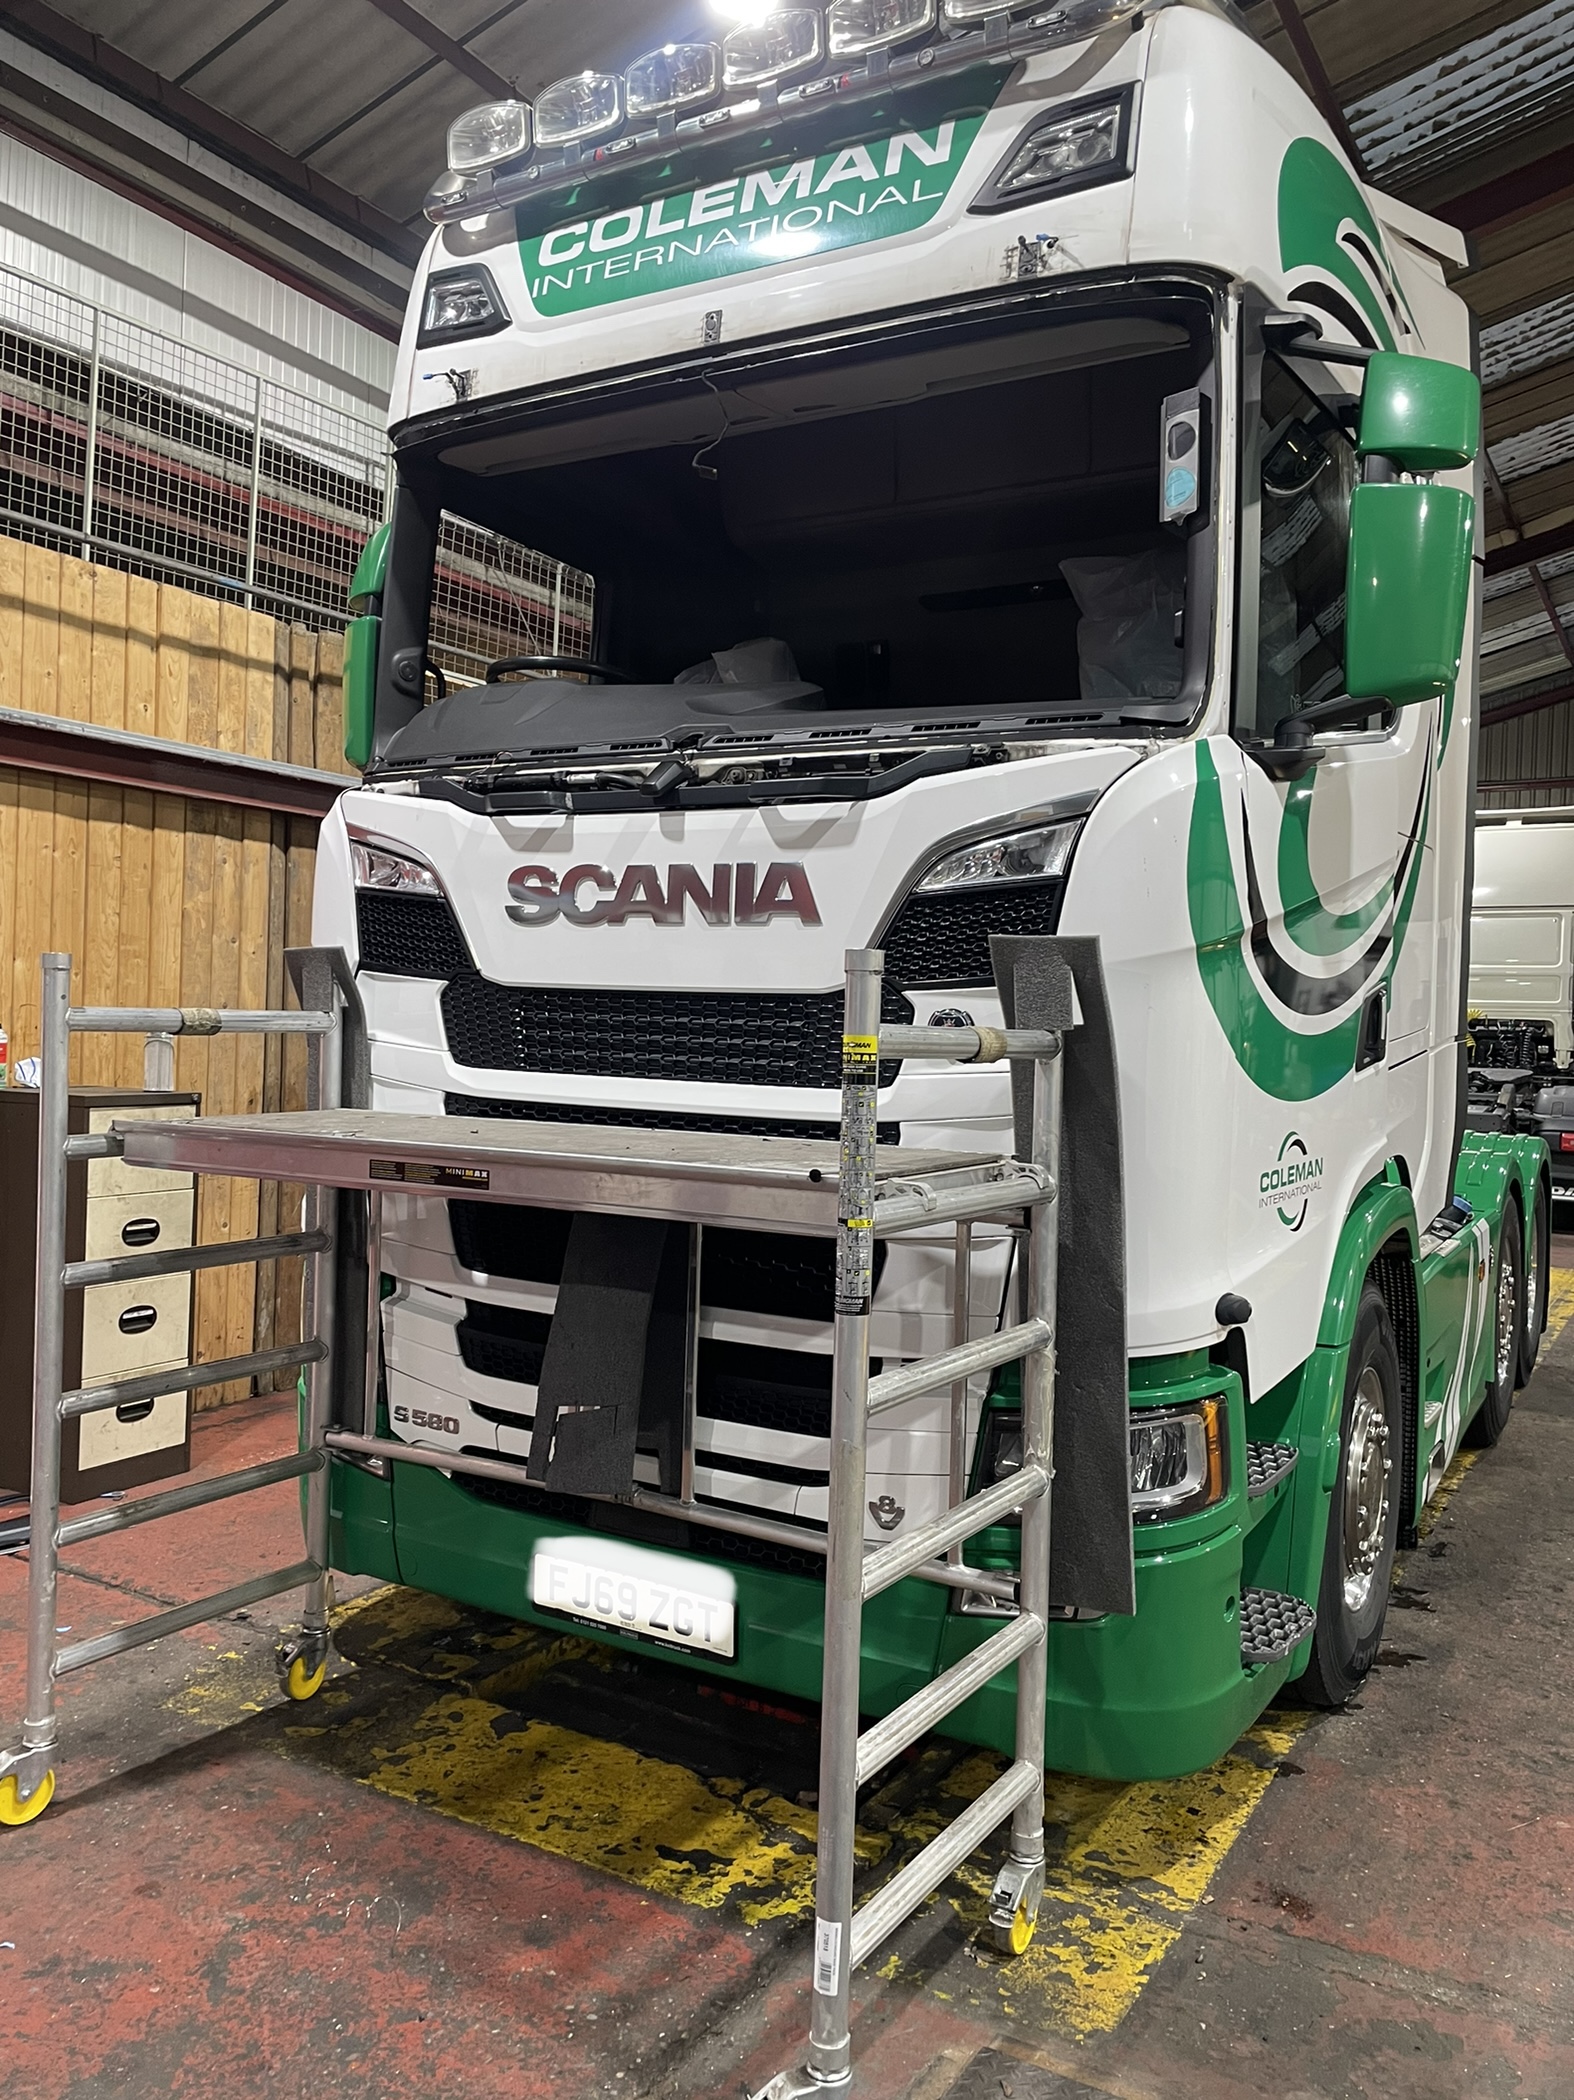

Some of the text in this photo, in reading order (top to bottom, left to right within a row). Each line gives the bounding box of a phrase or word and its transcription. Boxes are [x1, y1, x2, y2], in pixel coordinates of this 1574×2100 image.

[537, 118, 956, 267] COLEMAN
[531, 178, 945, 299] INTERNATIONAL
[504, 861, 824, 927] SCANIA
[445, 1167, 488, 1178] MINIMAX
[1258, 1181, 1322, 1208] INTERNATIONAL
[1259, 1157, 1324, 1193] COLEMAN
[393, 1405, 460, 1435] S 580
[550, 1563, 718, 1643] FJ69 ZGT
